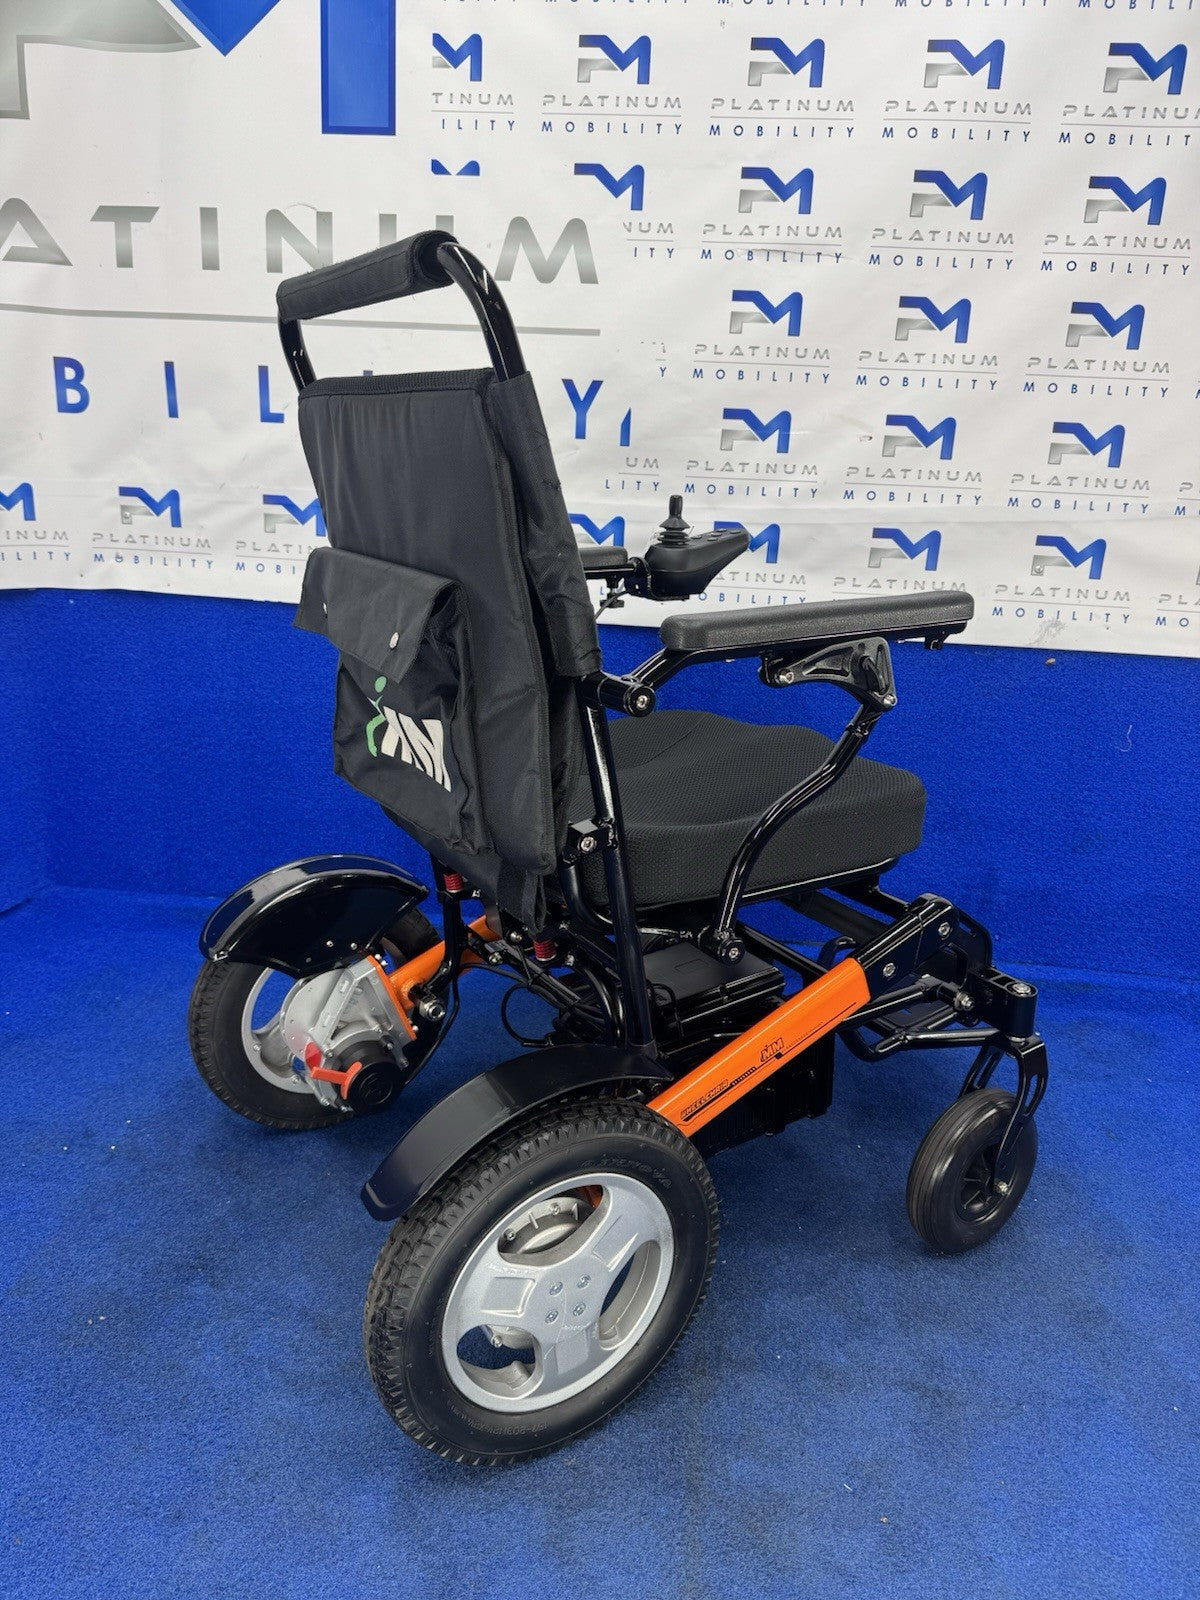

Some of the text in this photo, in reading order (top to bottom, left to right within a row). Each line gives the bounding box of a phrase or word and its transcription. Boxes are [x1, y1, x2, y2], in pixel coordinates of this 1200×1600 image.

[432, 92, 513, 105] TINUM
[541, 95, 681, 110] PLATINUM
[711, 98, 854, 112] PLATINUM
[885, 100, 1031, 115] PLATINUM
[442, 119, 515, 131] ILITY
[542, 121, 682, 135] MOBILITY
[709, 124, 854, 138] MOBILITY
[882, 127, 1030, 142] MOBILITY
[1058, 131, 1191, 146] MOBILIT
[703, 224, 842, 238] PLATINUM
[871, 228, 1014, 245] PLATINUM
[1044, 235, 1191, 250] PLATINUM
[701, 248, 843, 263] MOBILITY
[869, 254, 1013, 270] MOBILITY
[1040, 260, 1190, 275] MOBILITY
[694, 344, 830, 360] PLATINUM
[859, 351, 998, 366] PLATINUM
[1027, 357, 1169, 373] PLATINUM
[693, 368, 830, 384] MOBILITY
[856, 375, 999, 390] MOBILITY
[1023, 382, 1169, 398] MOBILITY
[686, 460, 817, 475] PLATINUM
[846, 467, 982, 482] PLATINUM
[605, 479, 660, 491] LITY
[1011, 474, 1150, 490] PLATINUM
[684, 483, 818, 499] MOBILITY
[843, 490, 982, 505] MOBILITY
[1007, 497, 1149, 514] MOBILITY
[92, 533, 211, 548] PLATINUM
[93, 552, 213, 569] MOBILITY
[236, 562, 296, 574] MOBI
[833, 577, 966, 591] PLATINUM
[993, 584, 1130, 602] PLATINUM
[992, 606, 1130, 624] MOBILITY
